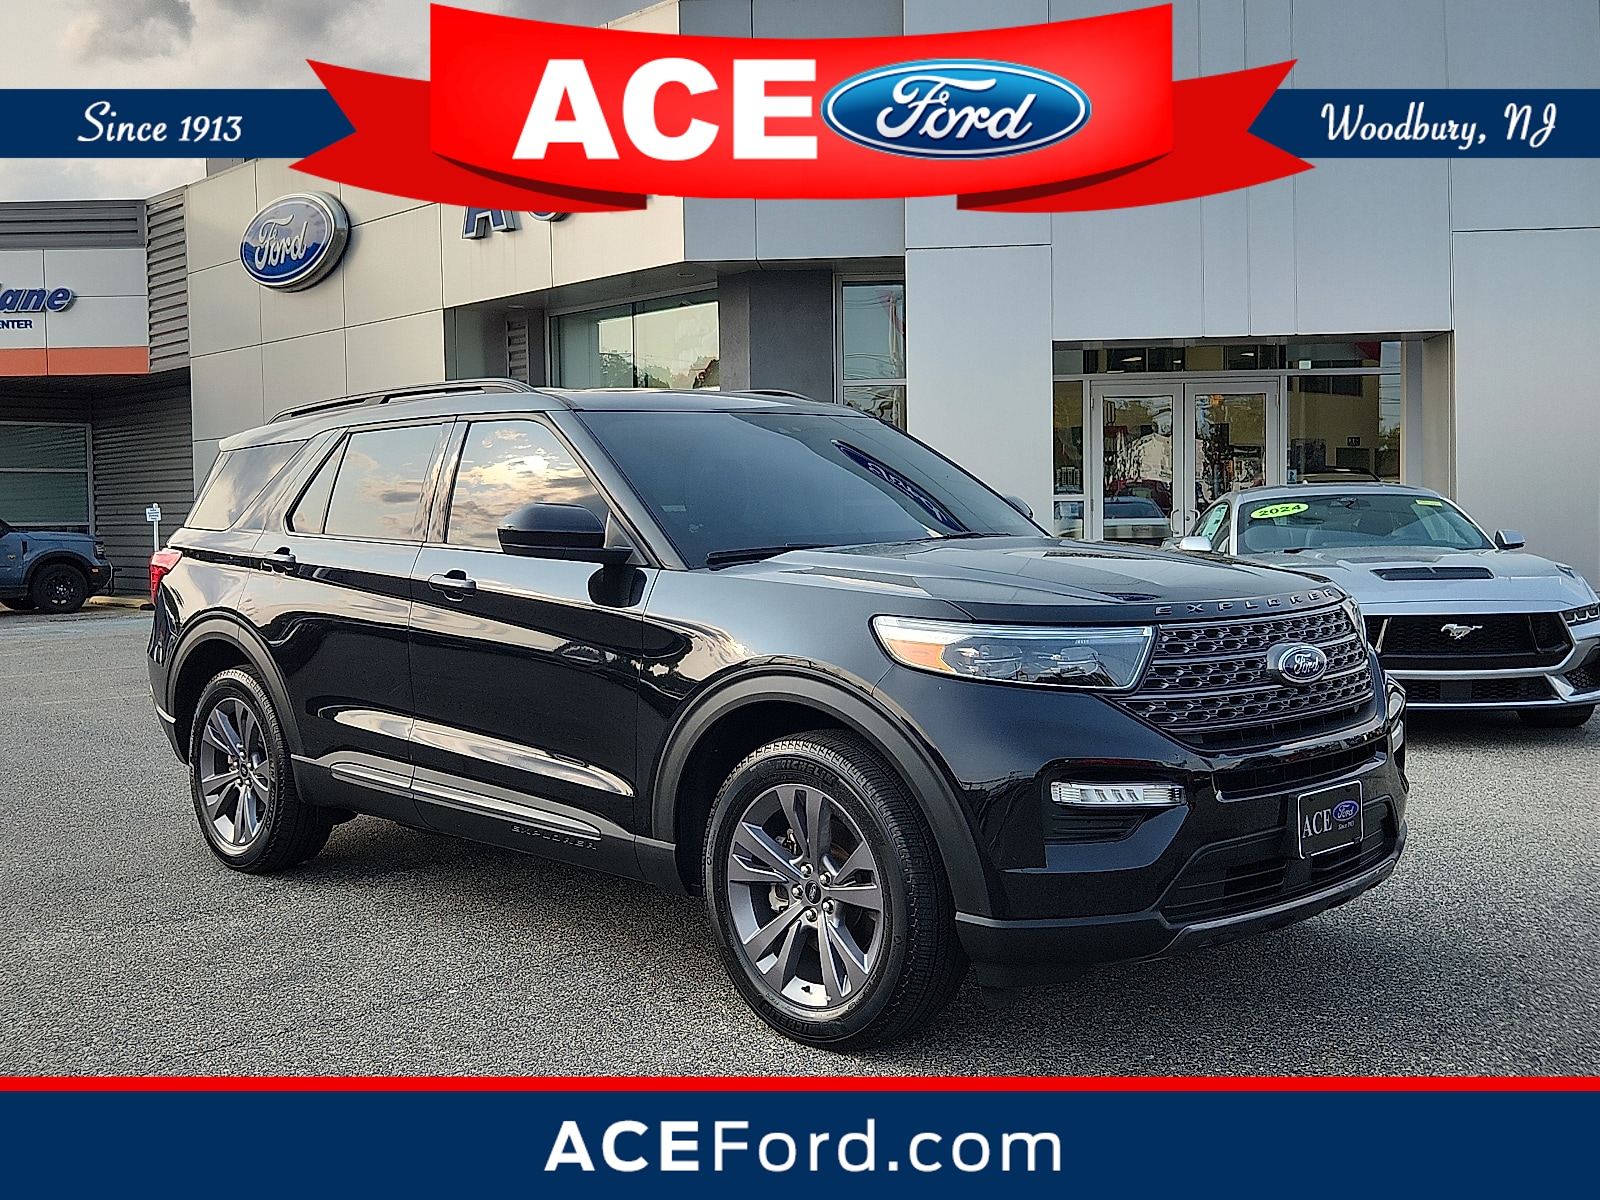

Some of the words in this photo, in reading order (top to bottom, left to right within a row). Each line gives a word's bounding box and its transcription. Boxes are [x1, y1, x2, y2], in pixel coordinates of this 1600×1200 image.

[254, 214, 309, 271] Ford
[0, 286, 74, 312] ane
[1258, 504, 1302, 517] 2024
[1154, 588, 1334, 617] EXPLORER
[1293, 652, 1320, 675] Ford
[1302, 808, 1333, 839] ACE
[1337, 804, 1355, 819] Ford
